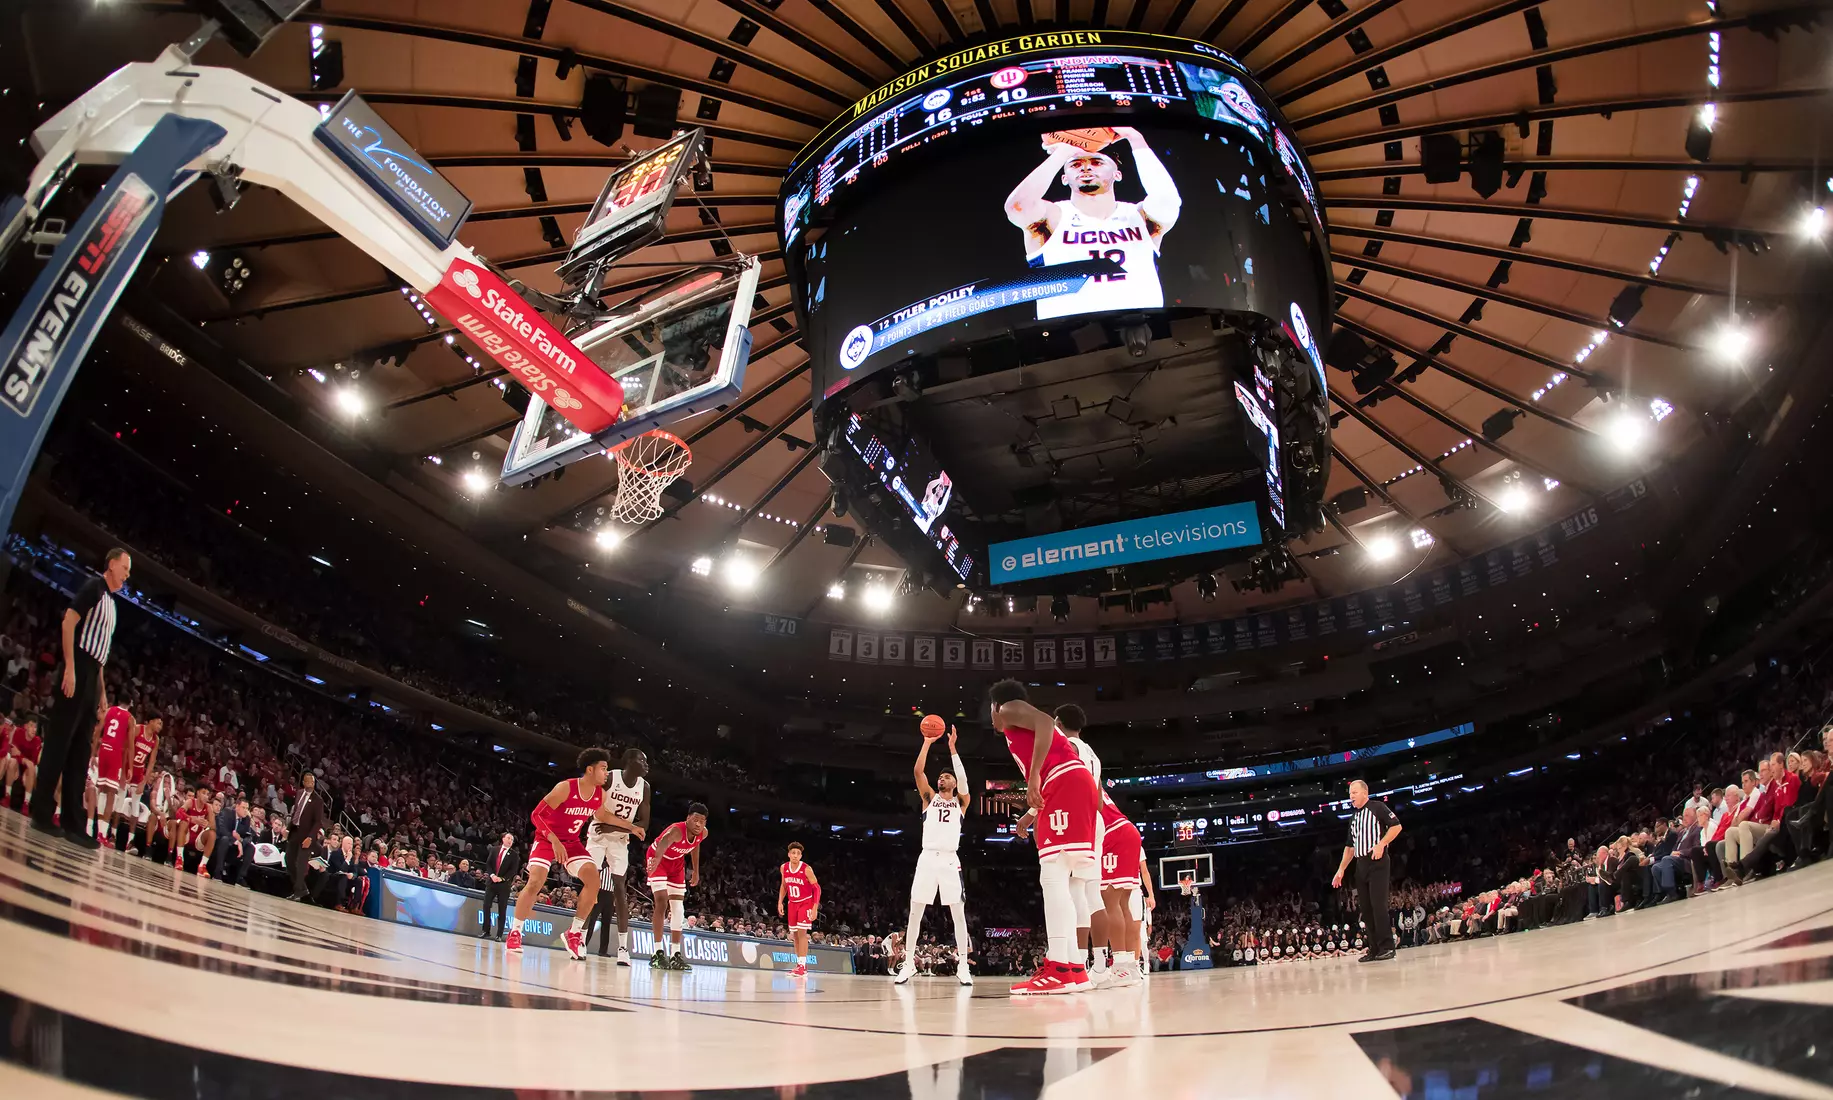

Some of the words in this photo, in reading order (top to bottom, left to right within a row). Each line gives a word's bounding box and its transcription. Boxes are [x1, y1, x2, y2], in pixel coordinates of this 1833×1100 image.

[1054, 56, 1123, 66] INDIANA
[853, 67, 929, 117] MADISON
[936, 41, 1012, 73] SQUARE
[1019, 32, 1101, 50] GARDEN
[960, 93, 986, 106] 9:52
[964, 88, 981, 96] 1st
[997, 88, 1028, 103] 10
[1116, 99, 1131, 107] 36
[854, 107, 897, 139] UCONN
[924, 107, 953, 127] 16
[961, 110, 989, 123] FOULS
[343, 117, 363, 138] THE
[78, 192, 145, 275] ESPN
[1063, 227, 1143, 245] UCONN
[879, 319, 890, 331] 12
[893, 302, 926, 324] TYLER
[929, 285, 976, 309] POLLEY
[879, 335, 886, 347] 7
[887, 326, 912, 342] POINTS
[926, 310, 943, 326] 2-2
[945, 303, 966, 320] FIELD
[969, 293, 996, 312] GOALS
[1012, 290, 1019, 301] 2
[1022, 281, 1069, 299] REBOUNDS
[5, 271, 88, 402] EVENTS
[160, 343, 187, 366] BRIDGE
[1575, 508, 1598, 531] 116
[1022, 534, 1125, 568] element
[1133, 520, 1247, 549] televisions
[779, 618, 796, 635] 70
[836, 639, 844, 653] 1
[863, 641, 872, 656] 3
[889, 643, 899, 658] 9
[919, 645, 930, 660] 2
[949, 646, 959, 661] 9
[1066, 646, 1083, 661] 19
[1101, 645, 1109, 659] 7
[976, 648, 990, 662] 11
[1004, 647, 1023, 663] 35
[1038, 648, 1051, 662] 11
[107, 719, 119, 738] 2
[134, 751, 147, 764] 21
[610, 791, 641, 806] UCONN
[615, 803, 632, 820] 23
[938, 809, 951, 823] 12
[191, 824, 199, 832] 4
[568, 819, 583, 834] 3
[1179, 829, 1193, 841] 30
[788, 885, 800, 898] 10
[525, 918, 542, 934] GIVE
[543, 922, 553, 936] UP
[683, 937, 728, 963] CLASSIC
[1185, 955, 1210, 963] Corona
